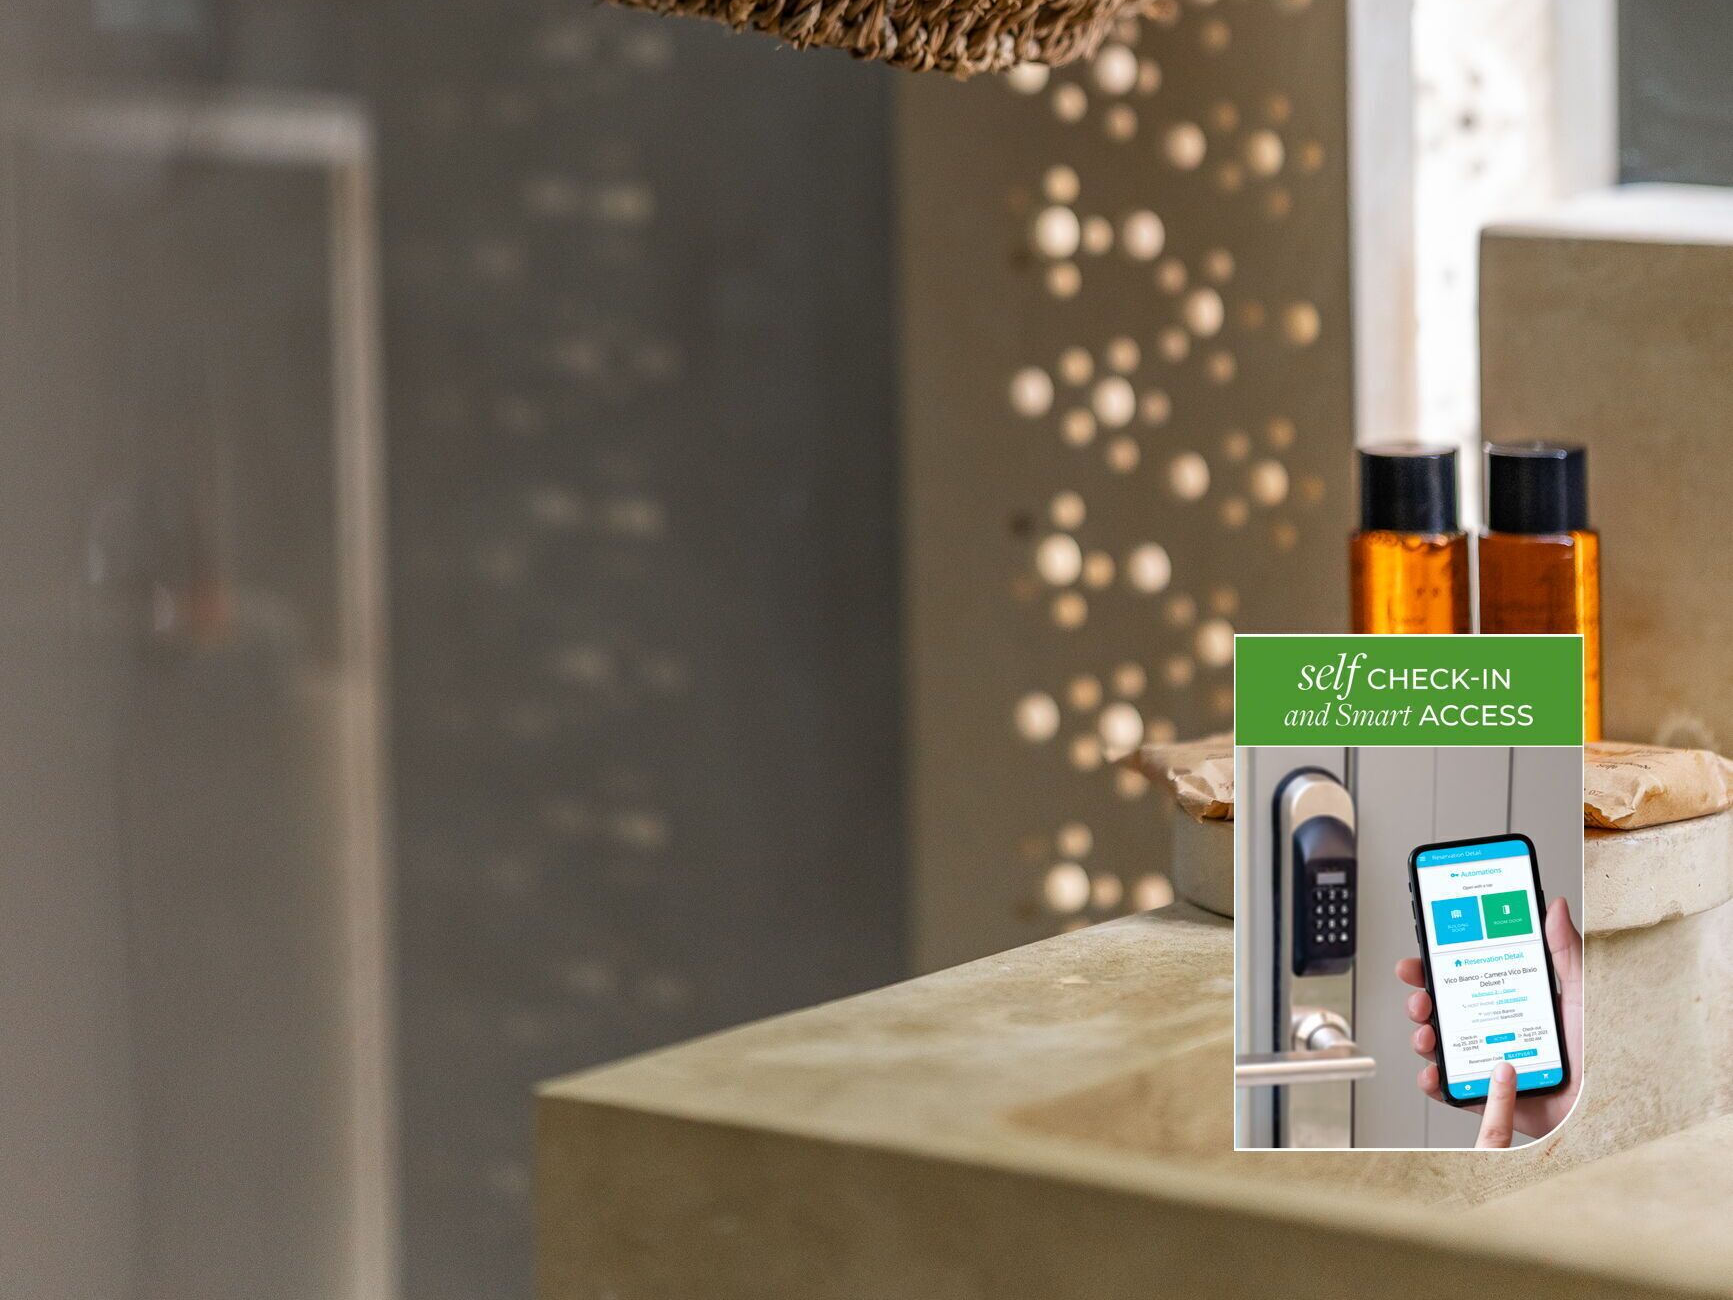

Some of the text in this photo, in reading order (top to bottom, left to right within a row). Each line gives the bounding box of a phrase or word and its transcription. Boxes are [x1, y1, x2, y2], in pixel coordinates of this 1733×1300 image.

[1465, 849, 1482, 857] Detail
[1460, 867, 1503, 878] Automations
[1464, 952, 1525, 965] Reservation Detail
[1443, 977, 1458, 985] Vico
[1458, 974, 1480, 983] Bianco
[1484, 970, 1508, 980] Camera
[1508, 969, 1522, 977] Vico
[1522, 966, 1538, 975] Bixio
[1480, 980, 1502, 988] Deluxe
